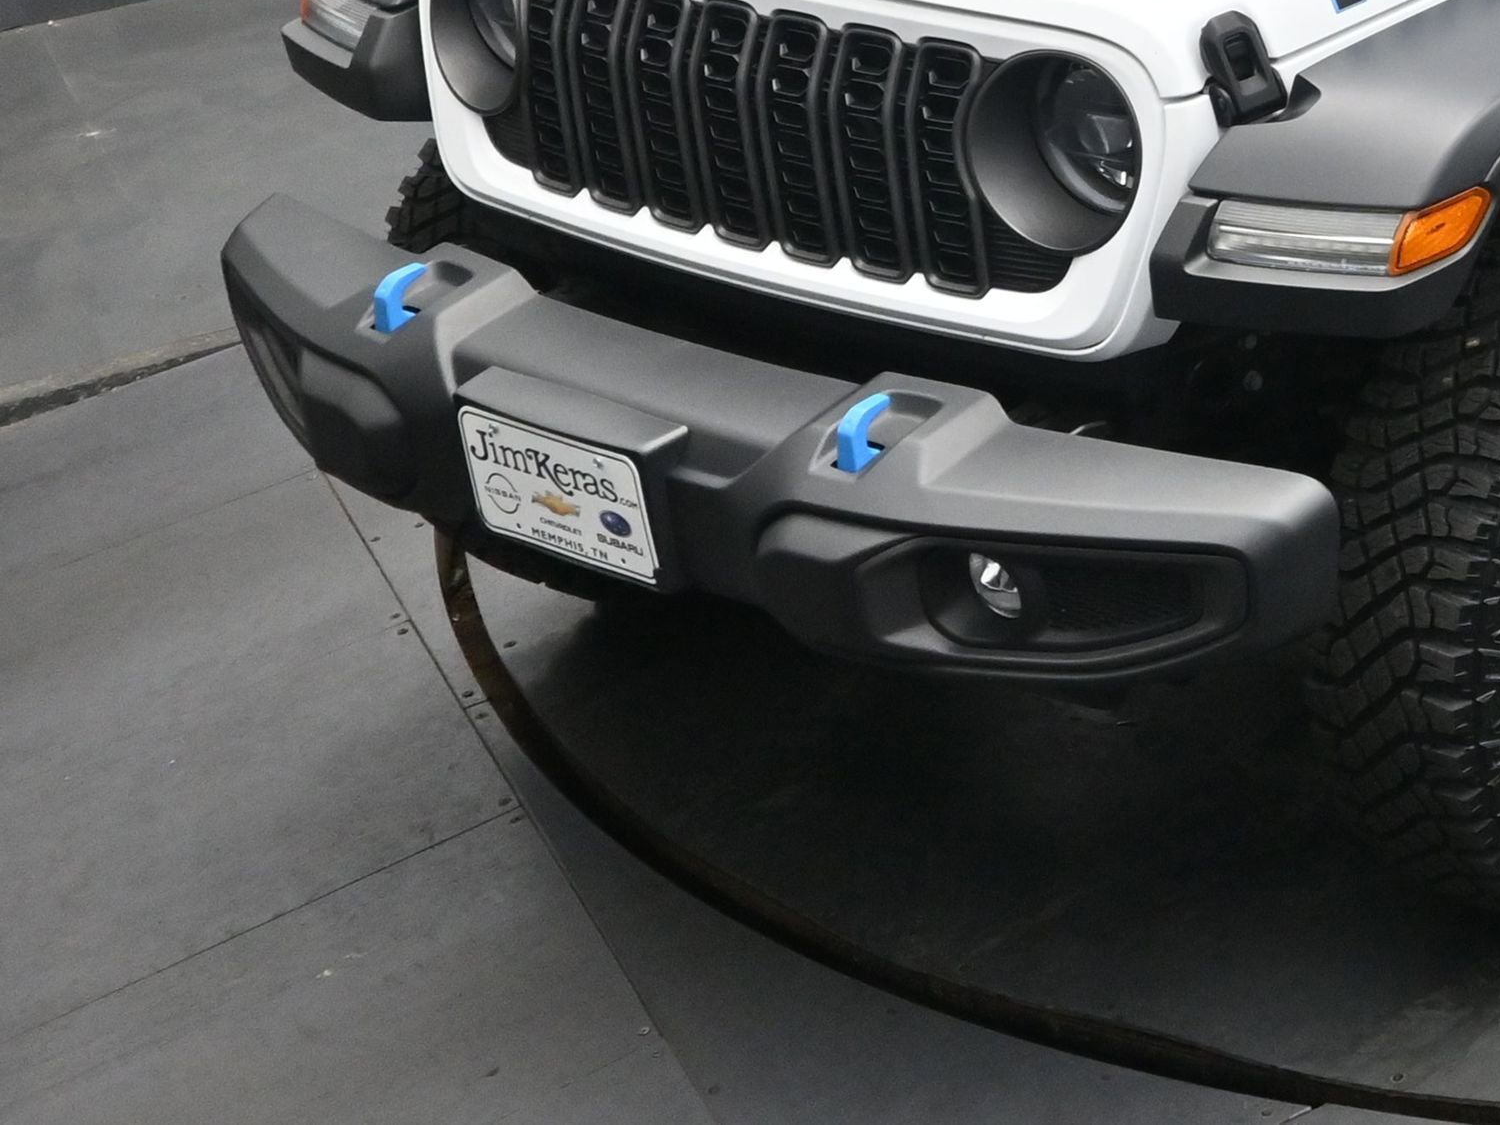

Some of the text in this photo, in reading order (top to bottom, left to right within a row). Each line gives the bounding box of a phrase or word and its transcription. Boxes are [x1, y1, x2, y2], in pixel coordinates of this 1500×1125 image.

[484, 485, 521, 502] NISSAN
[540, 516, 582, 536] CHEVROLET
[532, 528, 609, 561] MEMPHIS, TN
[596, 533, 644, 557] SUBARU
